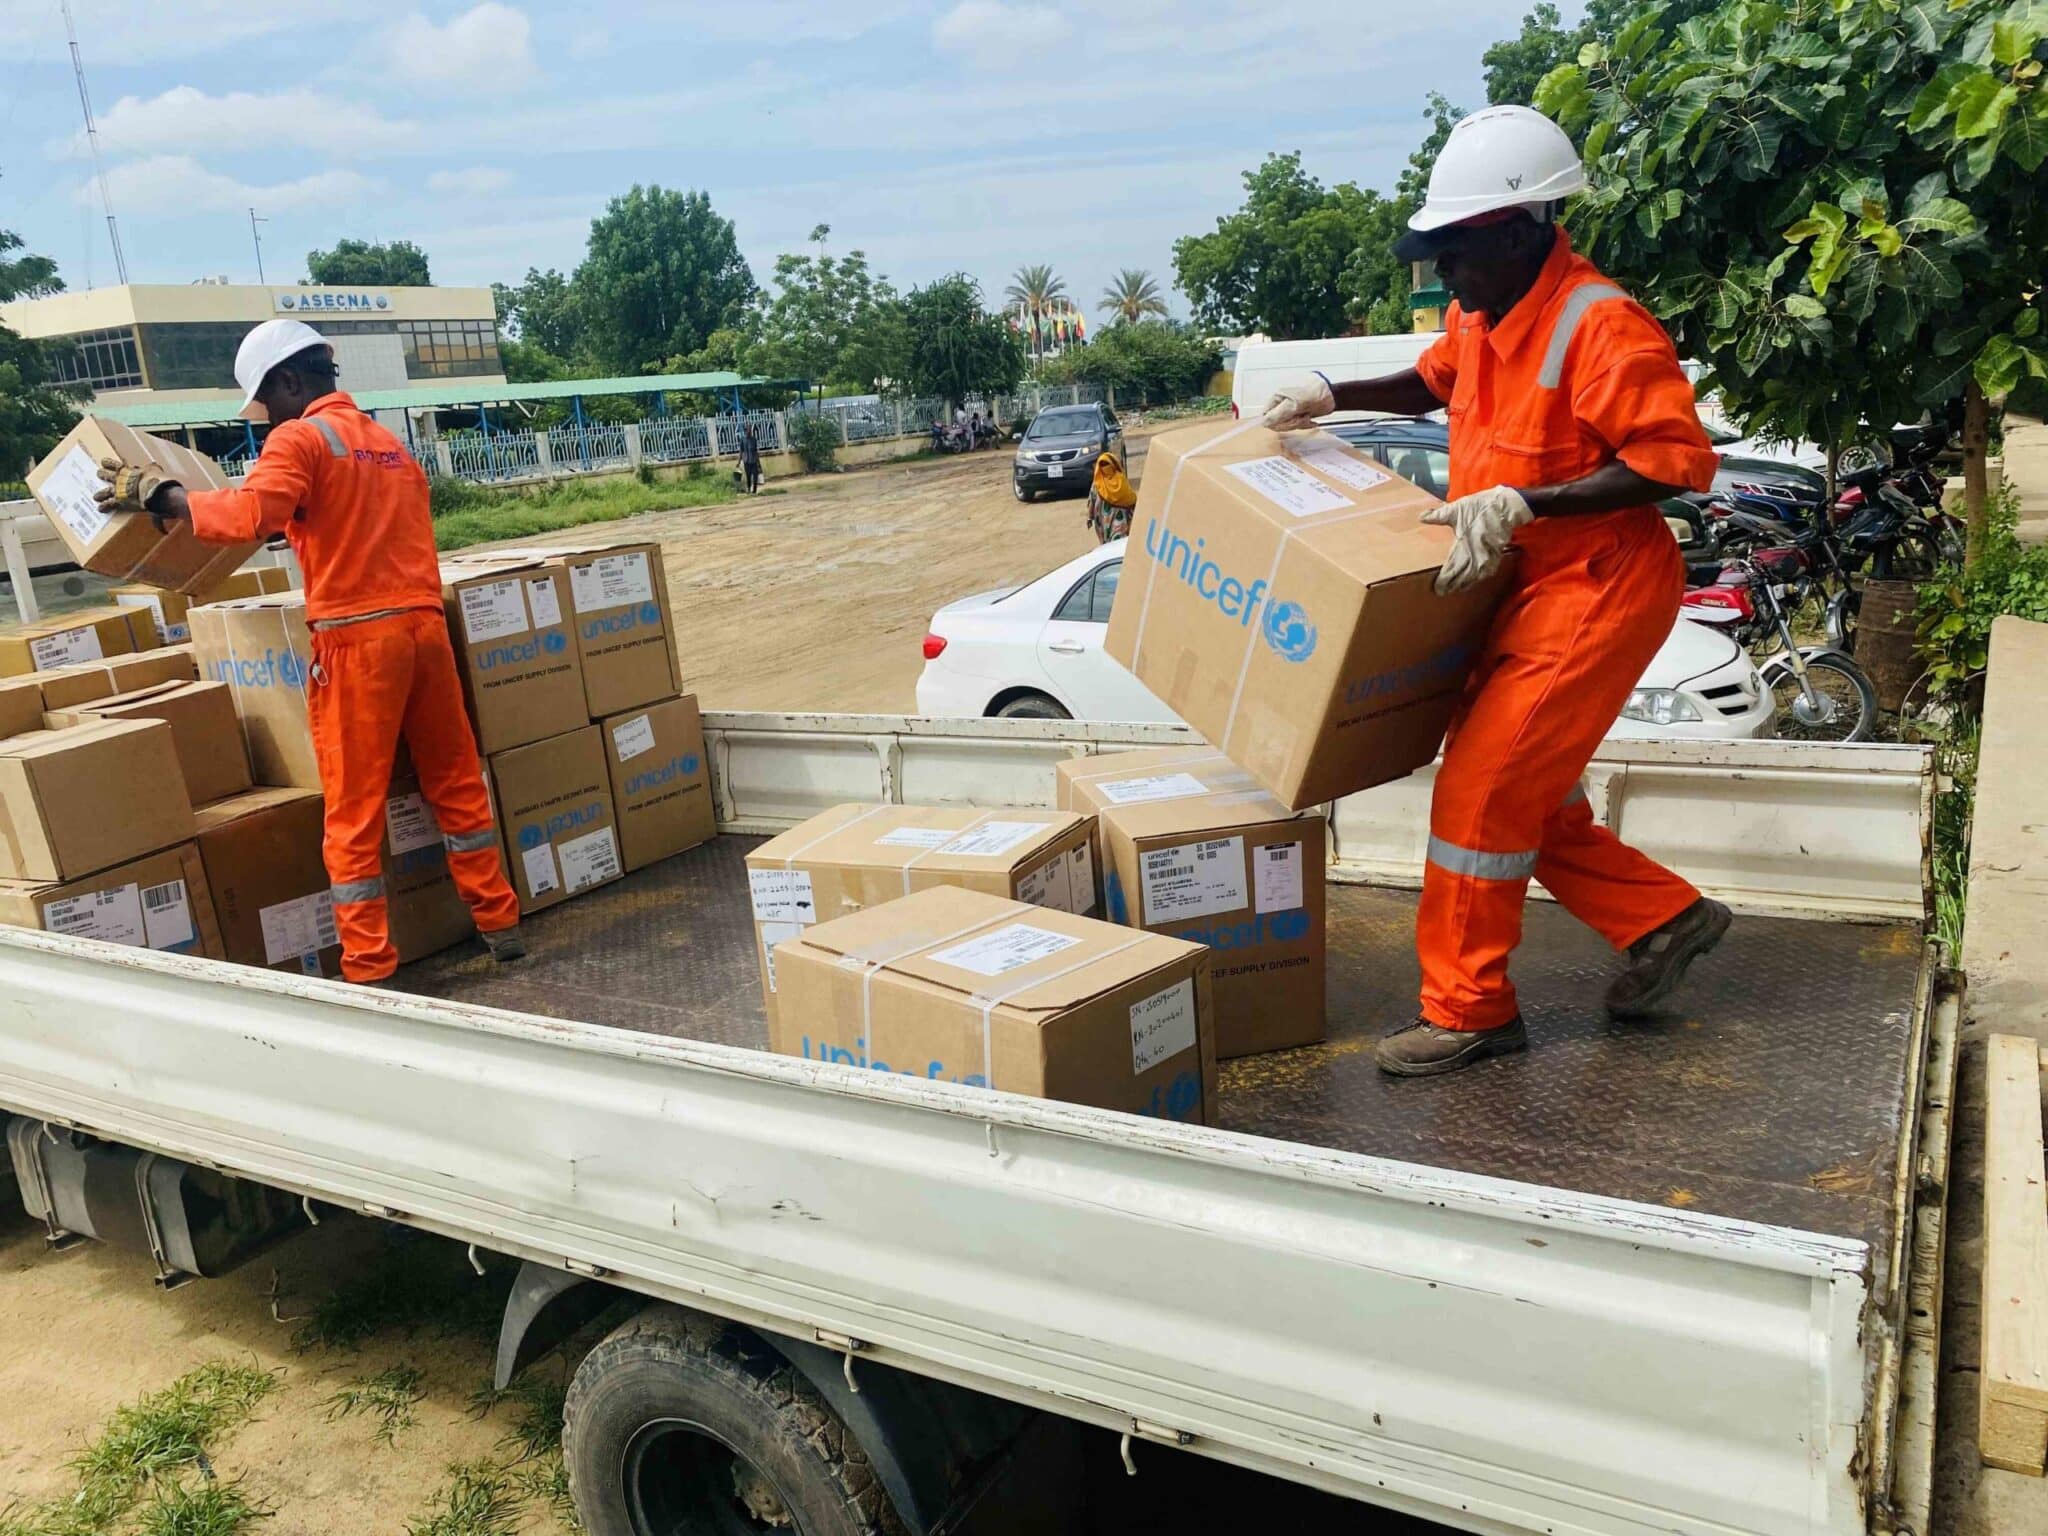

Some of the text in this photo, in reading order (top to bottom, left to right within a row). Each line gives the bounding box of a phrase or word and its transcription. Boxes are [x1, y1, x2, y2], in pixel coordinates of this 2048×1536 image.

[300, 294, 371, 307] ASECNA
[1145, 518, 1267, 628] unicef
[582, 605, 637, 641] unicef
[206, 648, 275, 688] unicef
[477, 635, 541, 671] unicef
[483, 664, 572, 689] FROM UNICEF SUPPLY DIVISION
[624, 757, 676, 796] unicef
[1229, 963, 1266, 977] SUPPLY
[1269, 955, 1311, 971] DIVISION
